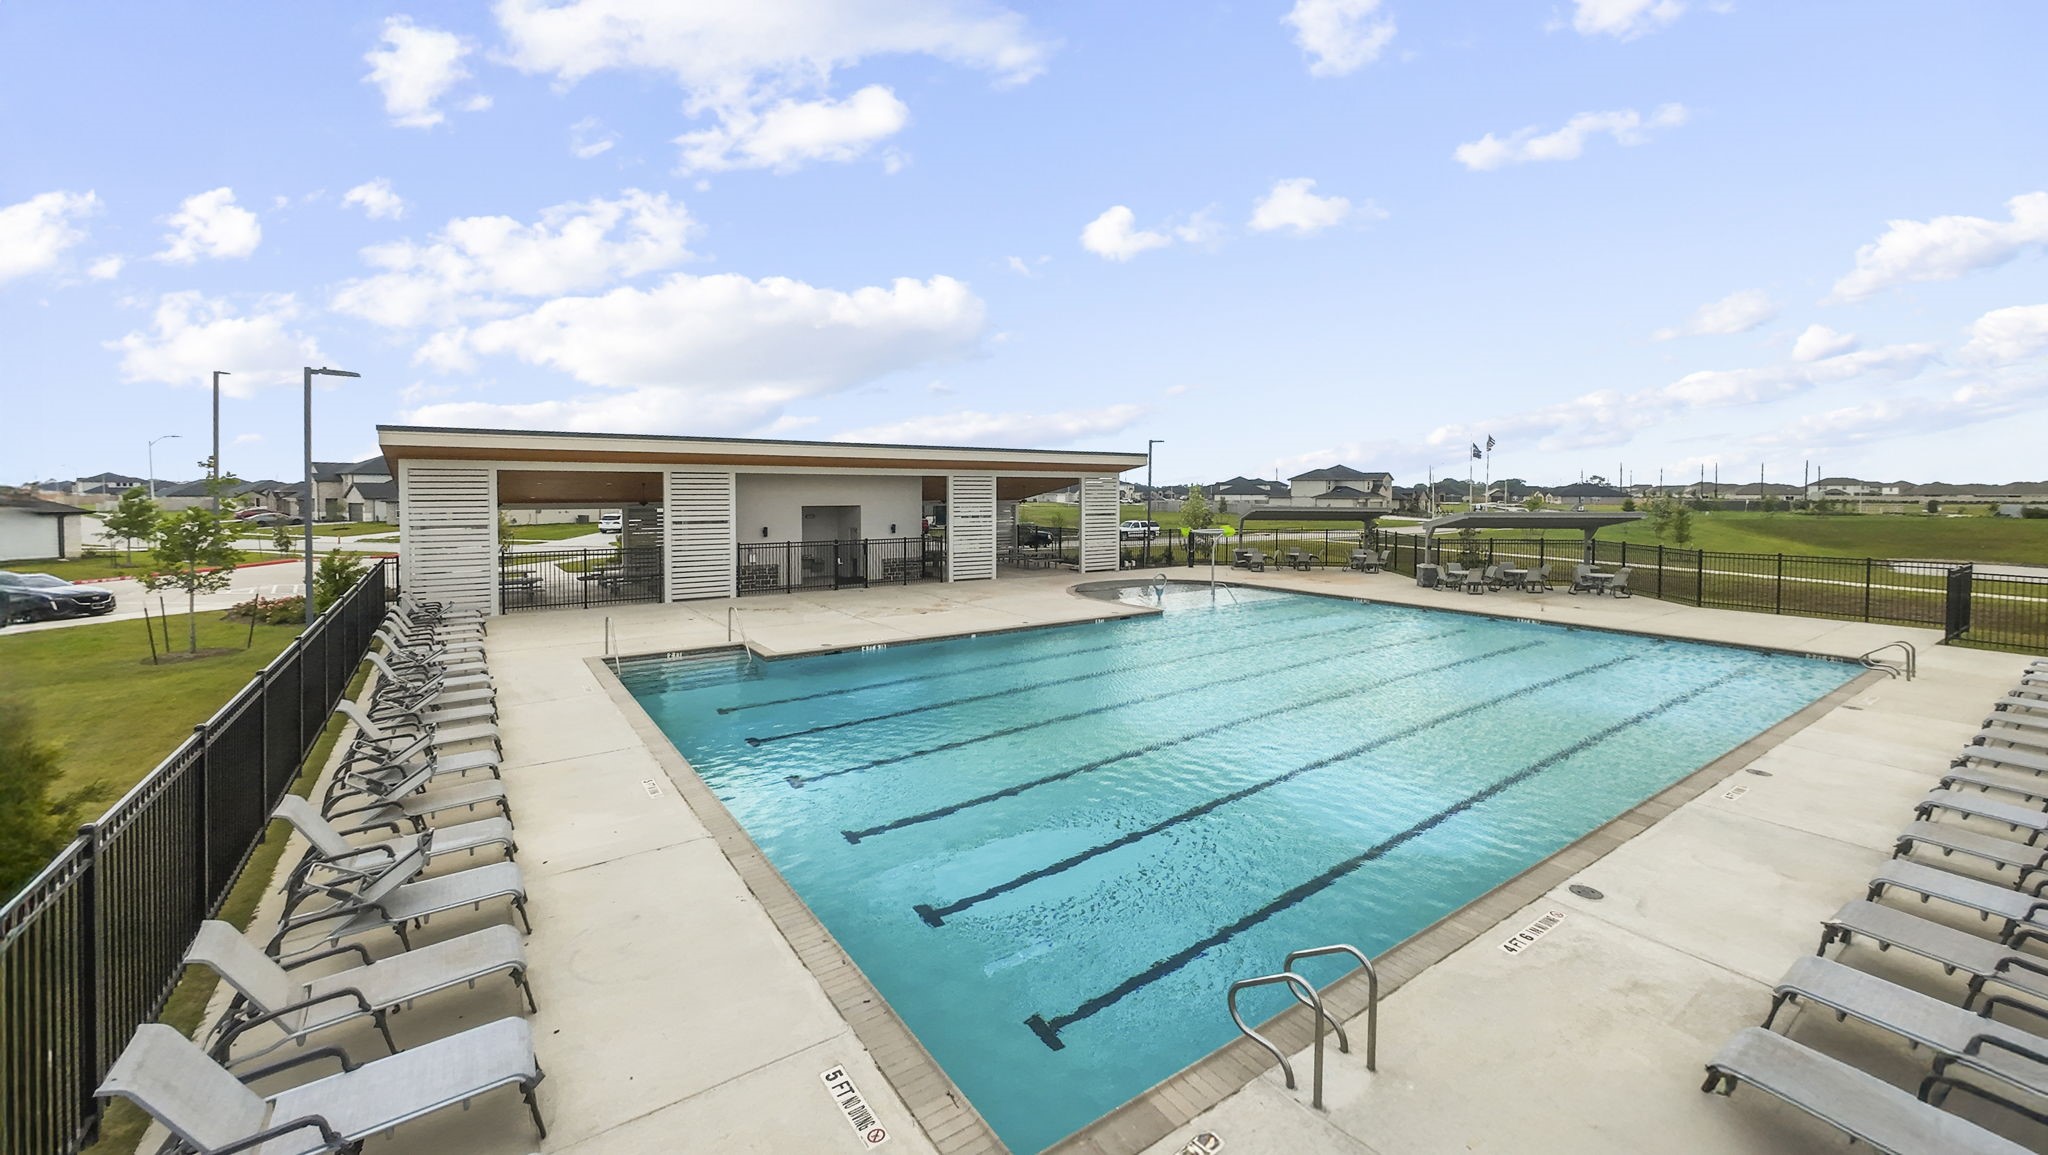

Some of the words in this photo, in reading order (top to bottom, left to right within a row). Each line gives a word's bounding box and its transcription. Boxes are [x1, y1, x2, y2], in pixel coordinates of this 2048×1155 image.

[1508, 937, 1528, 949] FT
[1519, 933, 1534, 941] 6
[1503, 944, 1518, 952] 4
[825, 1069, 844, 1082] 5
[831, 1080, 855, 1098] FT
[841, 1095, 861, 1109] NO
[847, 1104, 876, 1132] DIVING
